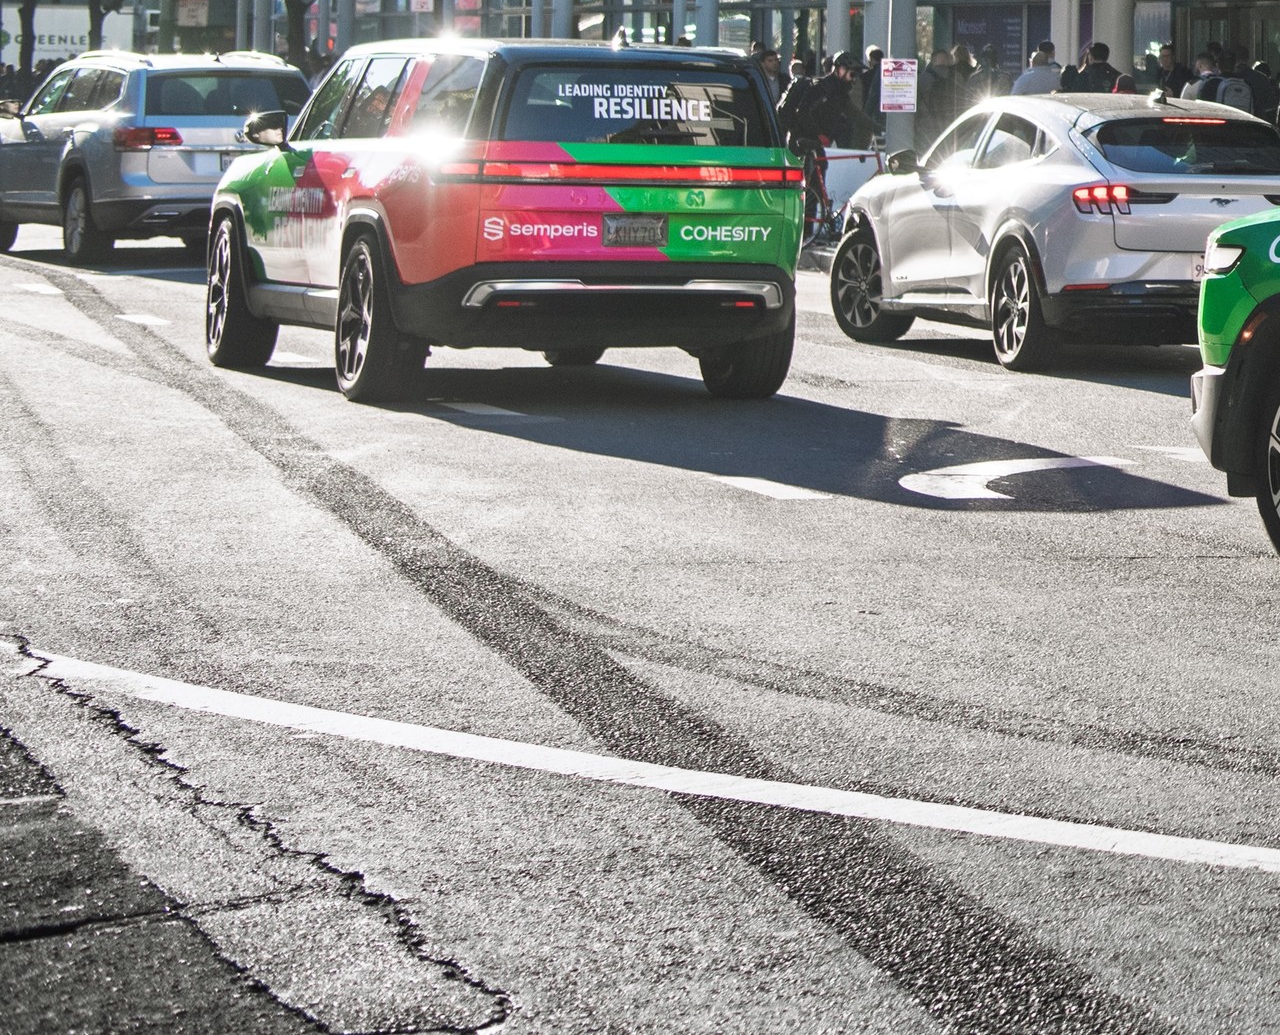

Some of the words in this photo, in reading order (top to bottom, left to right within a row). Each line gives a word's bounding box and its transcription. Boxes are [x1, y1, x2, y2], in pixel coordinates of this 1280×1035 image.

[558, 84, 611, 97] LEADING
[614, 84, 668, 98] IDENTITY
[594, 98, 711, 122] RESILIENCE
[510, 222, 598, 239] semperis
[680, 226, 772, 241] COHESITY
